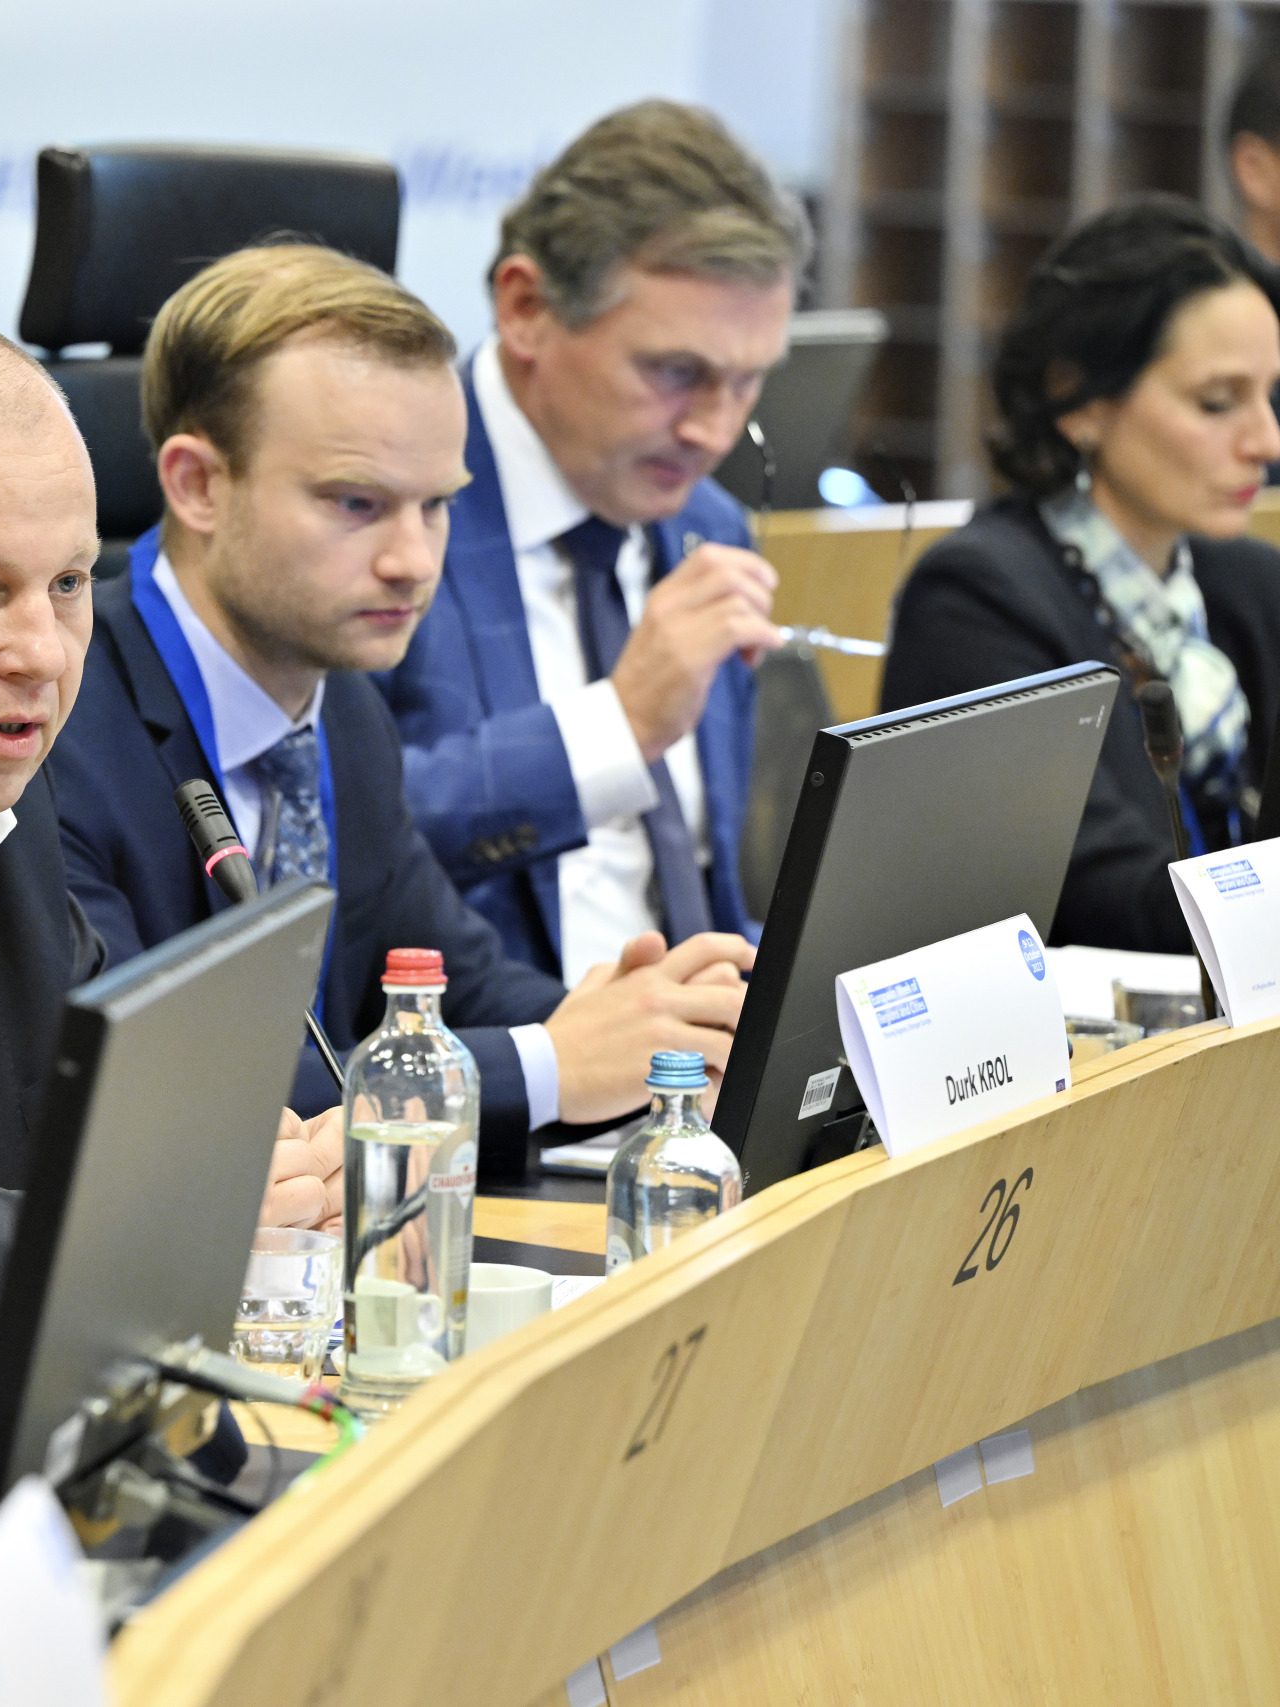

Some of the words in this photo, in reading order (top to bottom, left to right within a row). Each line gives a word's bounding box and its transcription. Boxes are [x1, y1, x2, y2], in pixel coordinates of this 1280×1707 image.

[945, 1066, 979, 1105] Durk
[977, 1054, 1014, 1093] KROL
[952, 1167, 1034, 1286] 26
[623, 1322, 709, 1463] 27
